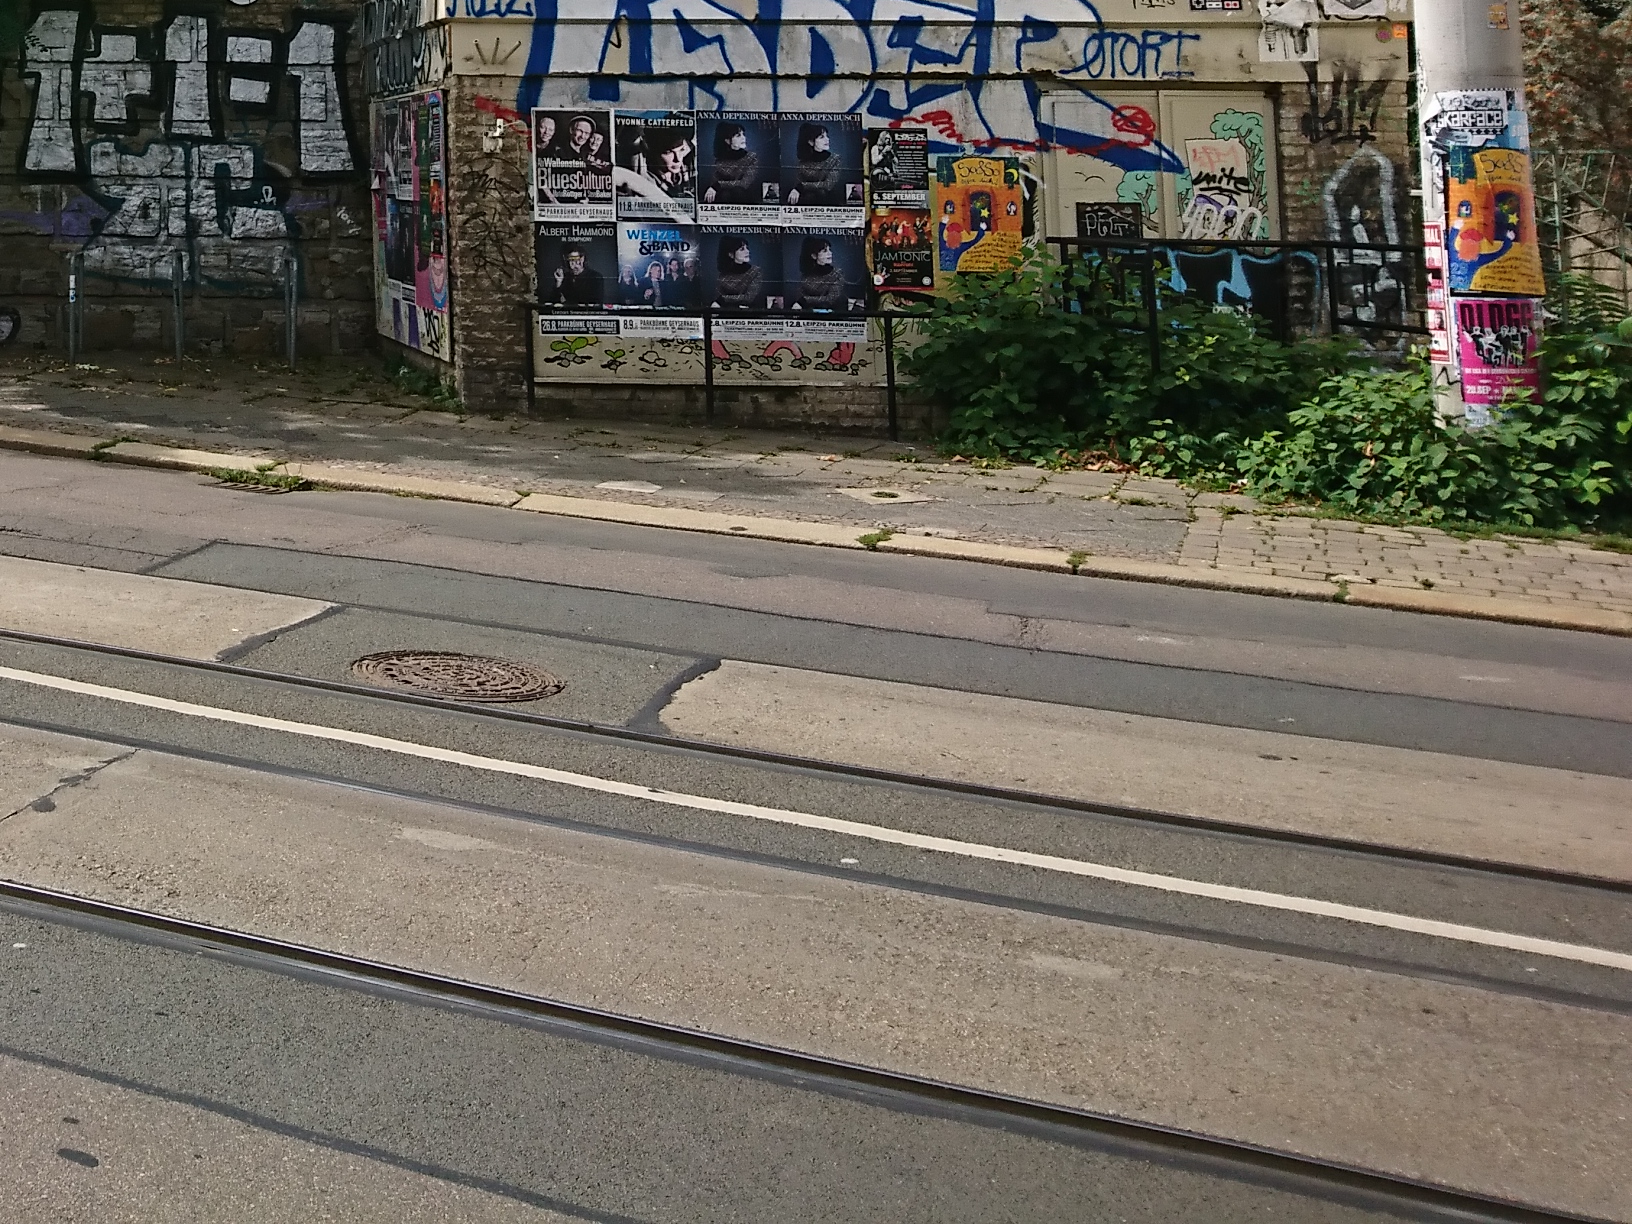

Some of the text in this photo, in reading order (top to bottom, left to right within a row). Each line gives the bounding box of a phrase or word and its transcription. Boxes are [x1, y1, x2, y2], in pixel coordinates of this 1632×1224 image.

[697, 112, 778, 121] ANNA DEPENBUSCH
[780, 113, 861, 122] ANNA DEPENBUSCH
[615, 118, 694, 127] YVONNE CATTERFELD
[537, 167, 613, 190] BluesCulture
[872, 193, 926, 201] 6. SEPTEMBER
[539, 225, 614, 237] ALBERT HAMMOND
[700, 226, 781, 234] ANNA DEPENBUSCH
[809, 227, 864, 237] DEPENBUSCH
[626, 229, 683, 241] WENZEL
